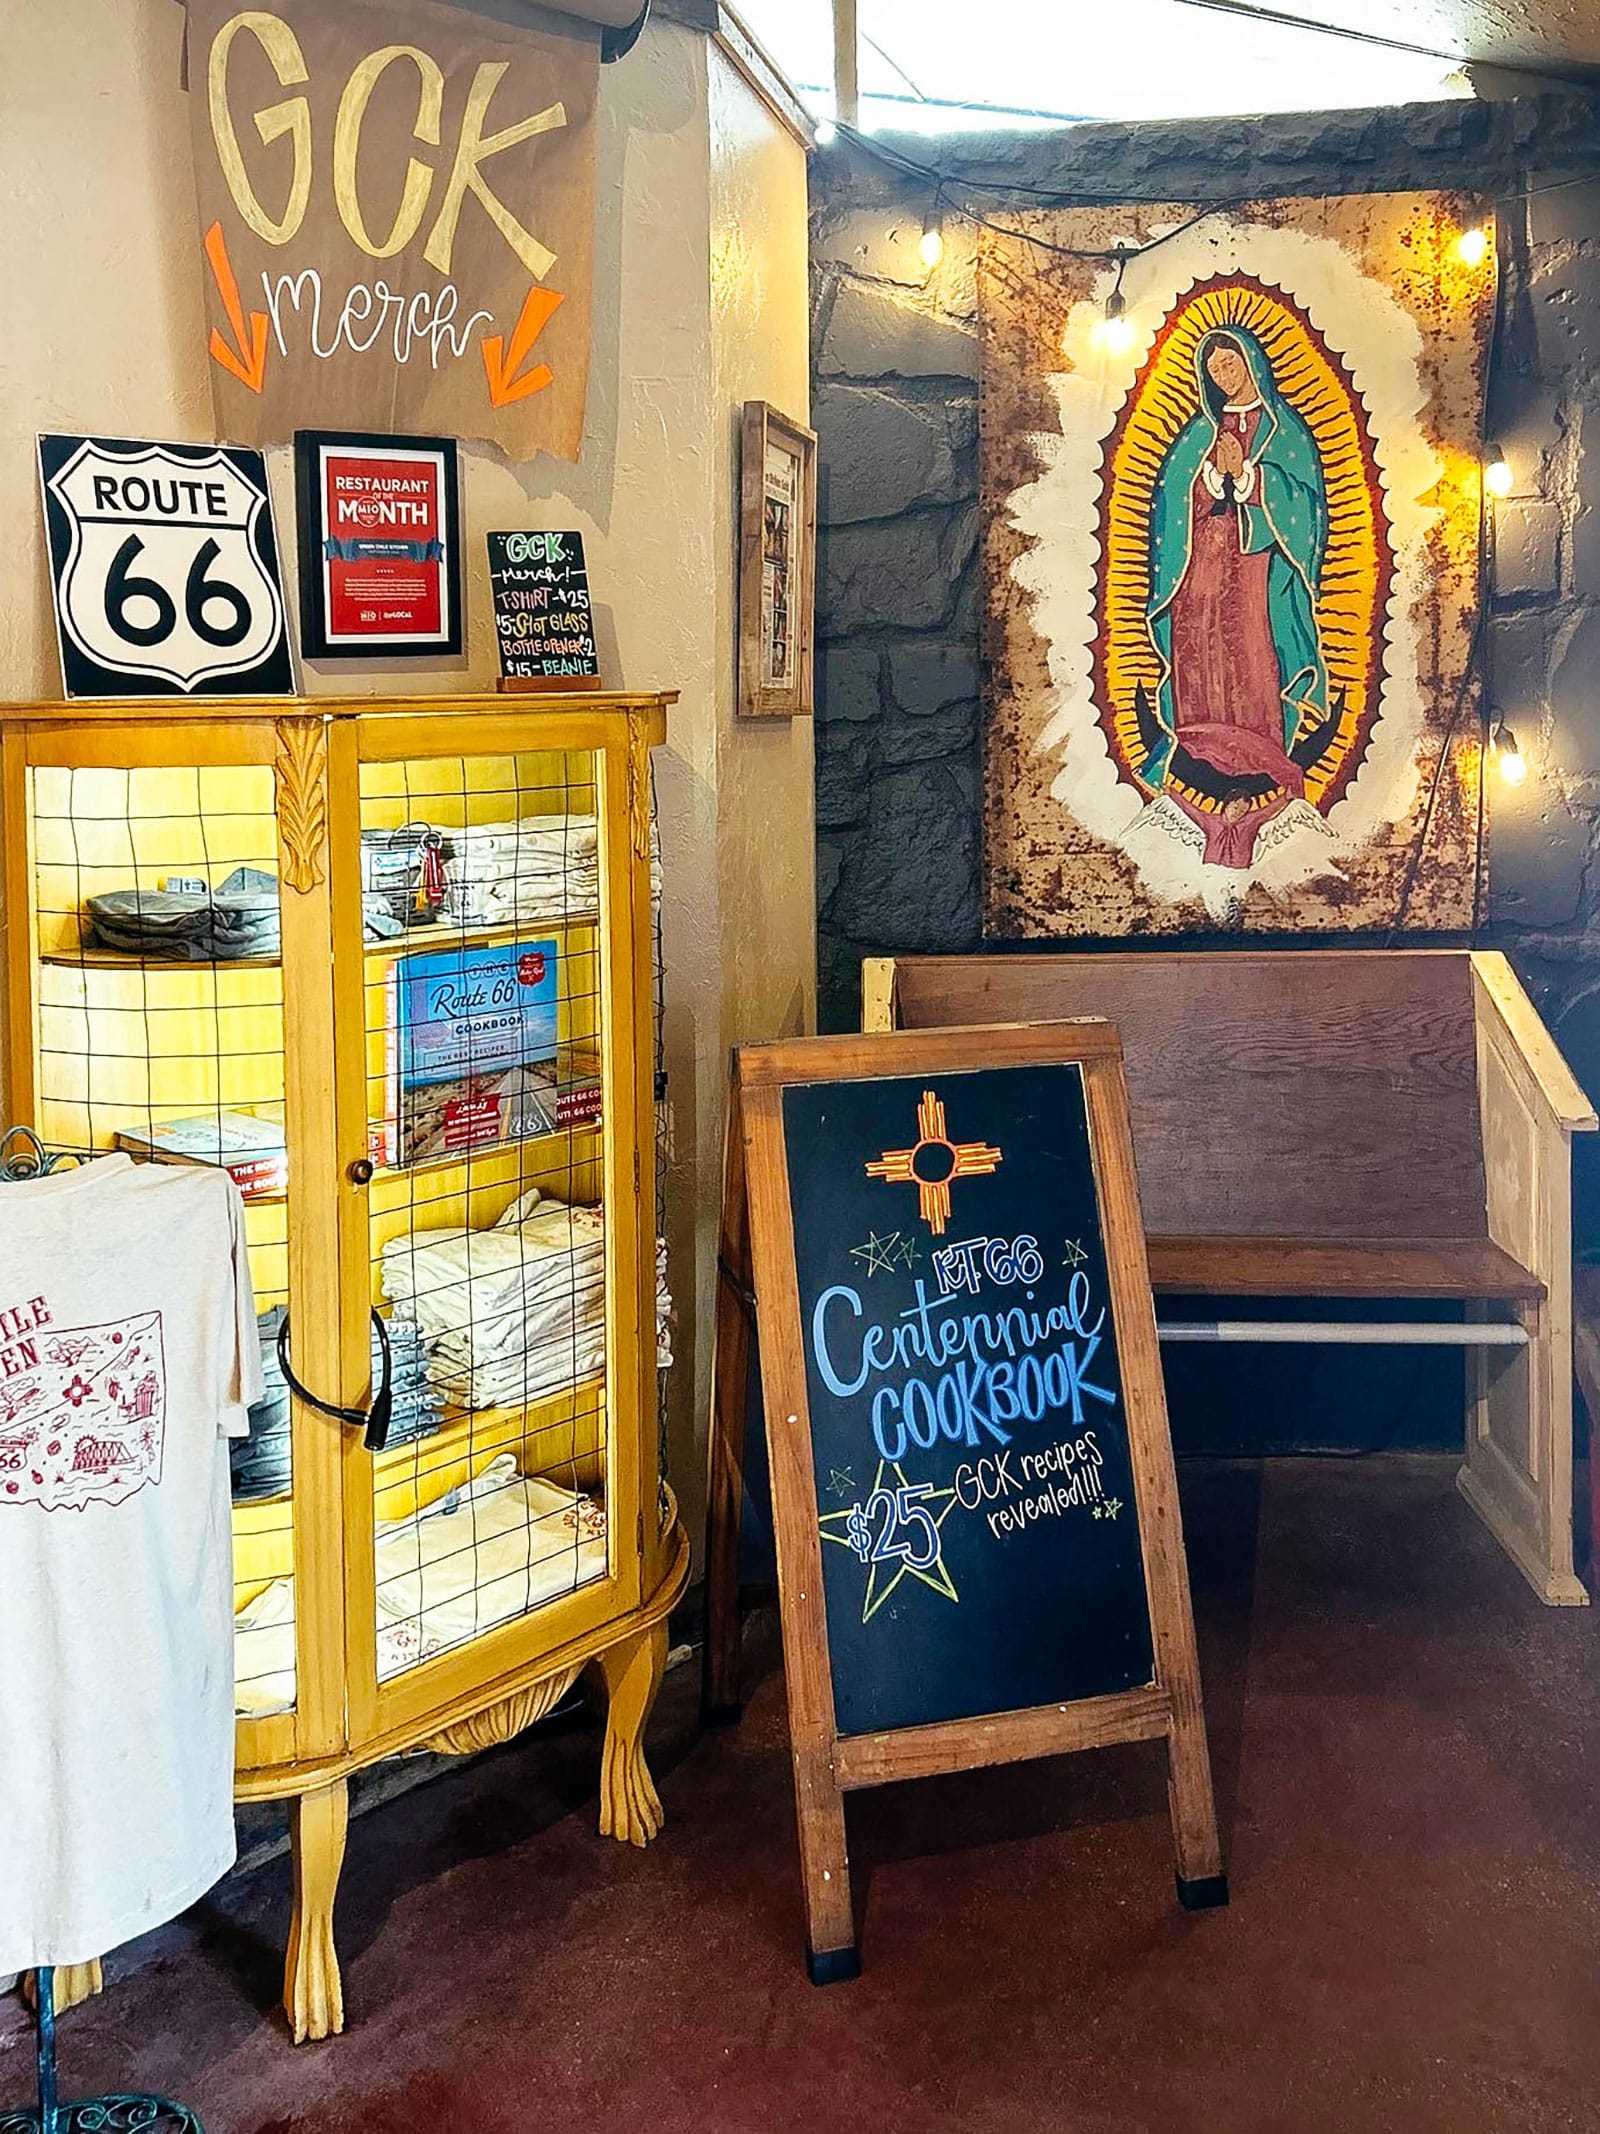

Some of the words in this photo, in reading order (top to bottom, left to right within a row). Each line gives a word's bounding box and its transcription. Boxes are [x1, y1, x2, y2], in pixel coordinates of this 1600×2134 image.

[208, 11, 567, 280] GCK
[92, 475, 228, 517] ROUTE
[335, 475, 429, 494] RESTAURANT
[506, 533, 567, 563] GCK
[104, 533, 252, 647] 66
[496, 586, 552, 610] T-SHIRT
[549, 612, 589, 634] GLASS
[501, 639, 541, 657] BOTTLE
[543, 636, 584, 656] OPENER
[506, 659, 532, 677] $15
[542, 657, 592, 675] BEANIE
[430, 984, 487, 1019] Route
[491, 978, 516, 1004] 66
[455, 1016, 524, 1035] COOKBOOK
[233, 1164, 254, 1177] THE
[238, 1182, 253, 1192] HE
[983, 1234, 1044, 1285] 66
[812, 1271, 1106, 1398] Centennial
[870, 1336, 1116, 1463] COOKBOOK
[955, 1450, 1023, 1509] GCK
[1020, 1431, 1104, 1480] recipes
[986, 1464, 1105, 1539] revealed!!!
[846, 1482, 941, 1570] $25
